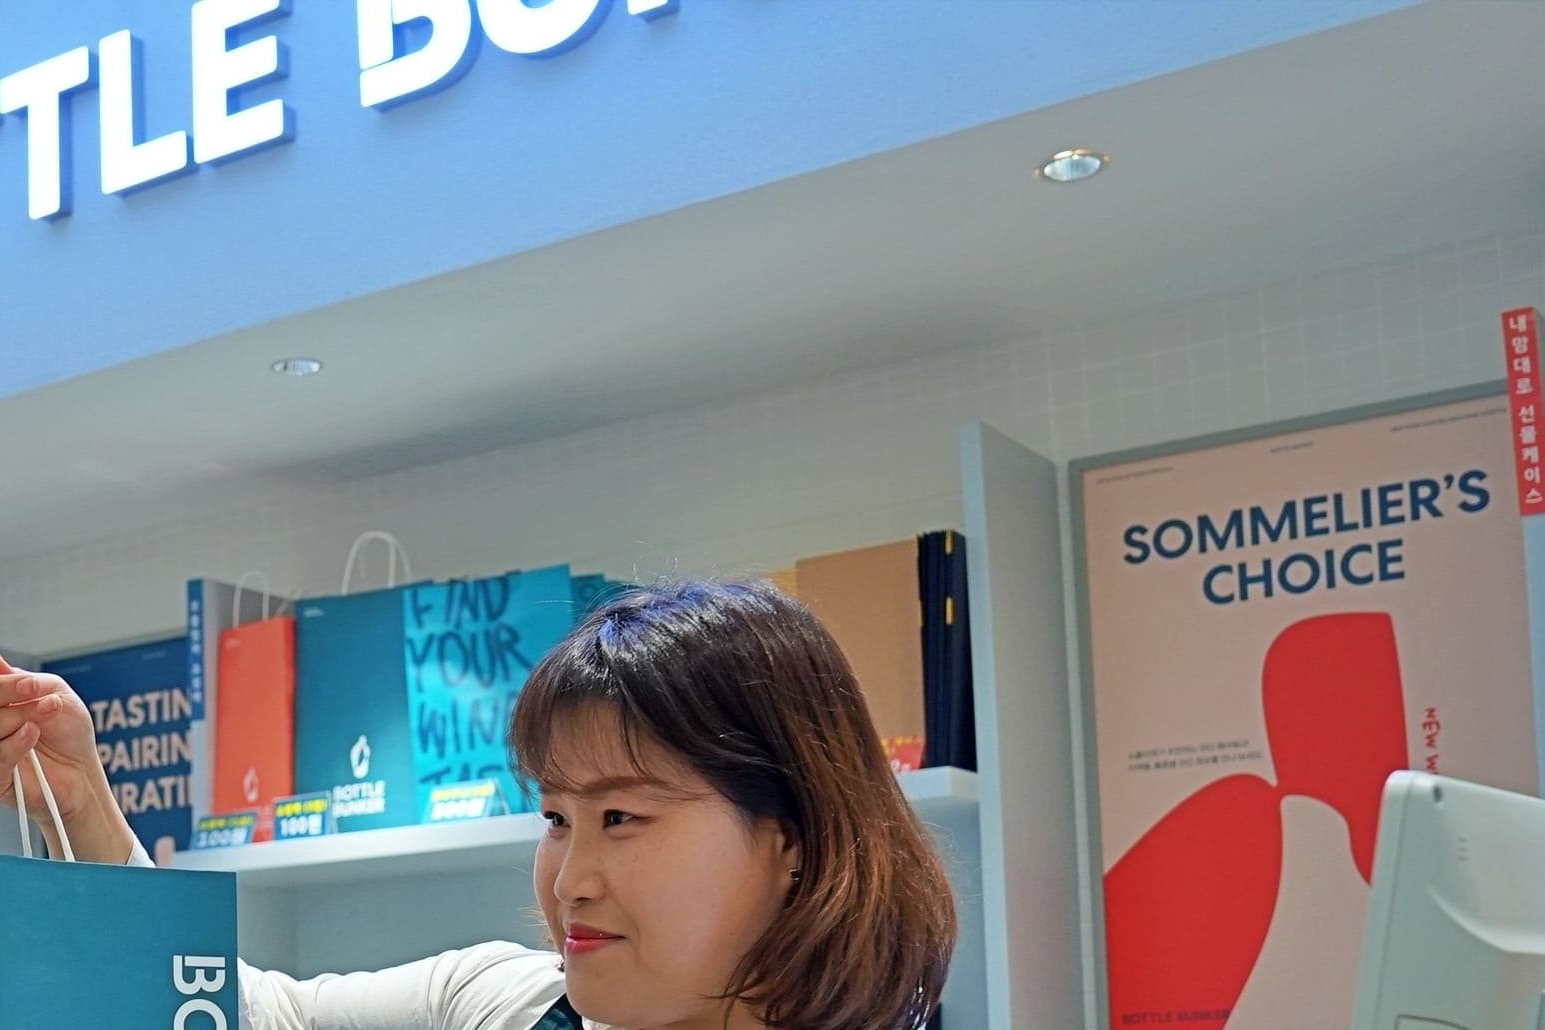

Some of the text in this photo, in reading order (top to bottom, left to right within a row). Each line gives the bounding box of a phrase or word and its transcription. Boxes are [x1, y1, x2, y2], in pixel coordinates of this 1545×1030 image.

[1122, 470, 1491, 565] SOMMELIER'S
[1202, 539, 1406, 605] CHOICE
[405, 623, 535, 693] YOUR
[418, 691, 516, 759] WIN
[1422, 706, 1441, 749] NEW
